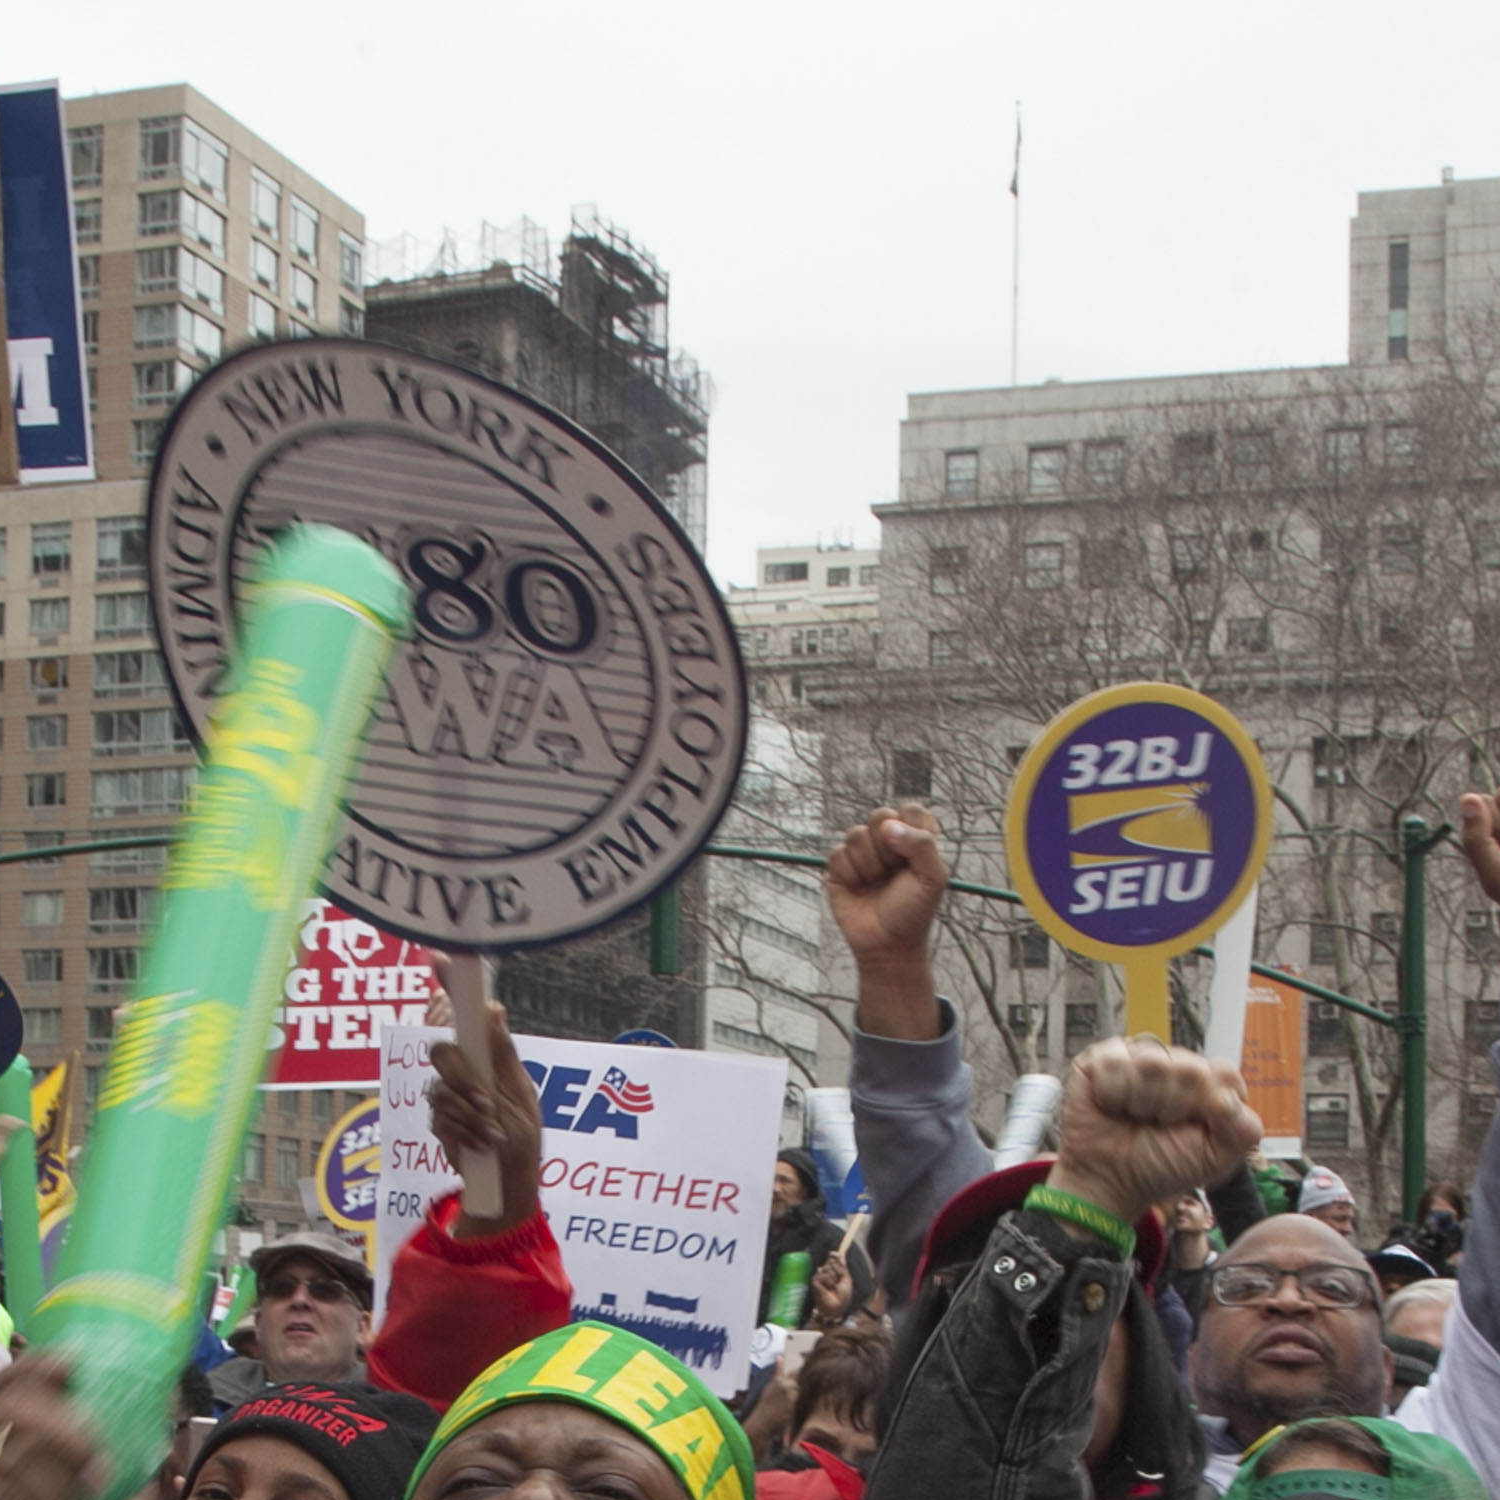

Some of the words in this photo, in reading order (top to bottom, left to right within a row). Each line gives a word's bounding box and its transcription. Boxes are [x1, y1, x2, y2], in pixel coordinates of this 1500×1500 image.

[220, 357, 345, 448] NEW
[368, 355, 576, 492] YORK
[382, 652, 622, 772] WA
[554, 530, 730, 905] EMPLOYEES
[1062, 732, 1213, 790] 32BJ
[1069, 857, 1215, 914] SEIU
[332, 966, 431, 1001] THE
[387, 1191, 421, 1218] FOR
[538, 1157, 740, 1215] OGETHER
[564, 1216, 738, 1265] FREEDOM
[231, 1398, 358, 1447] ORGANIZER
